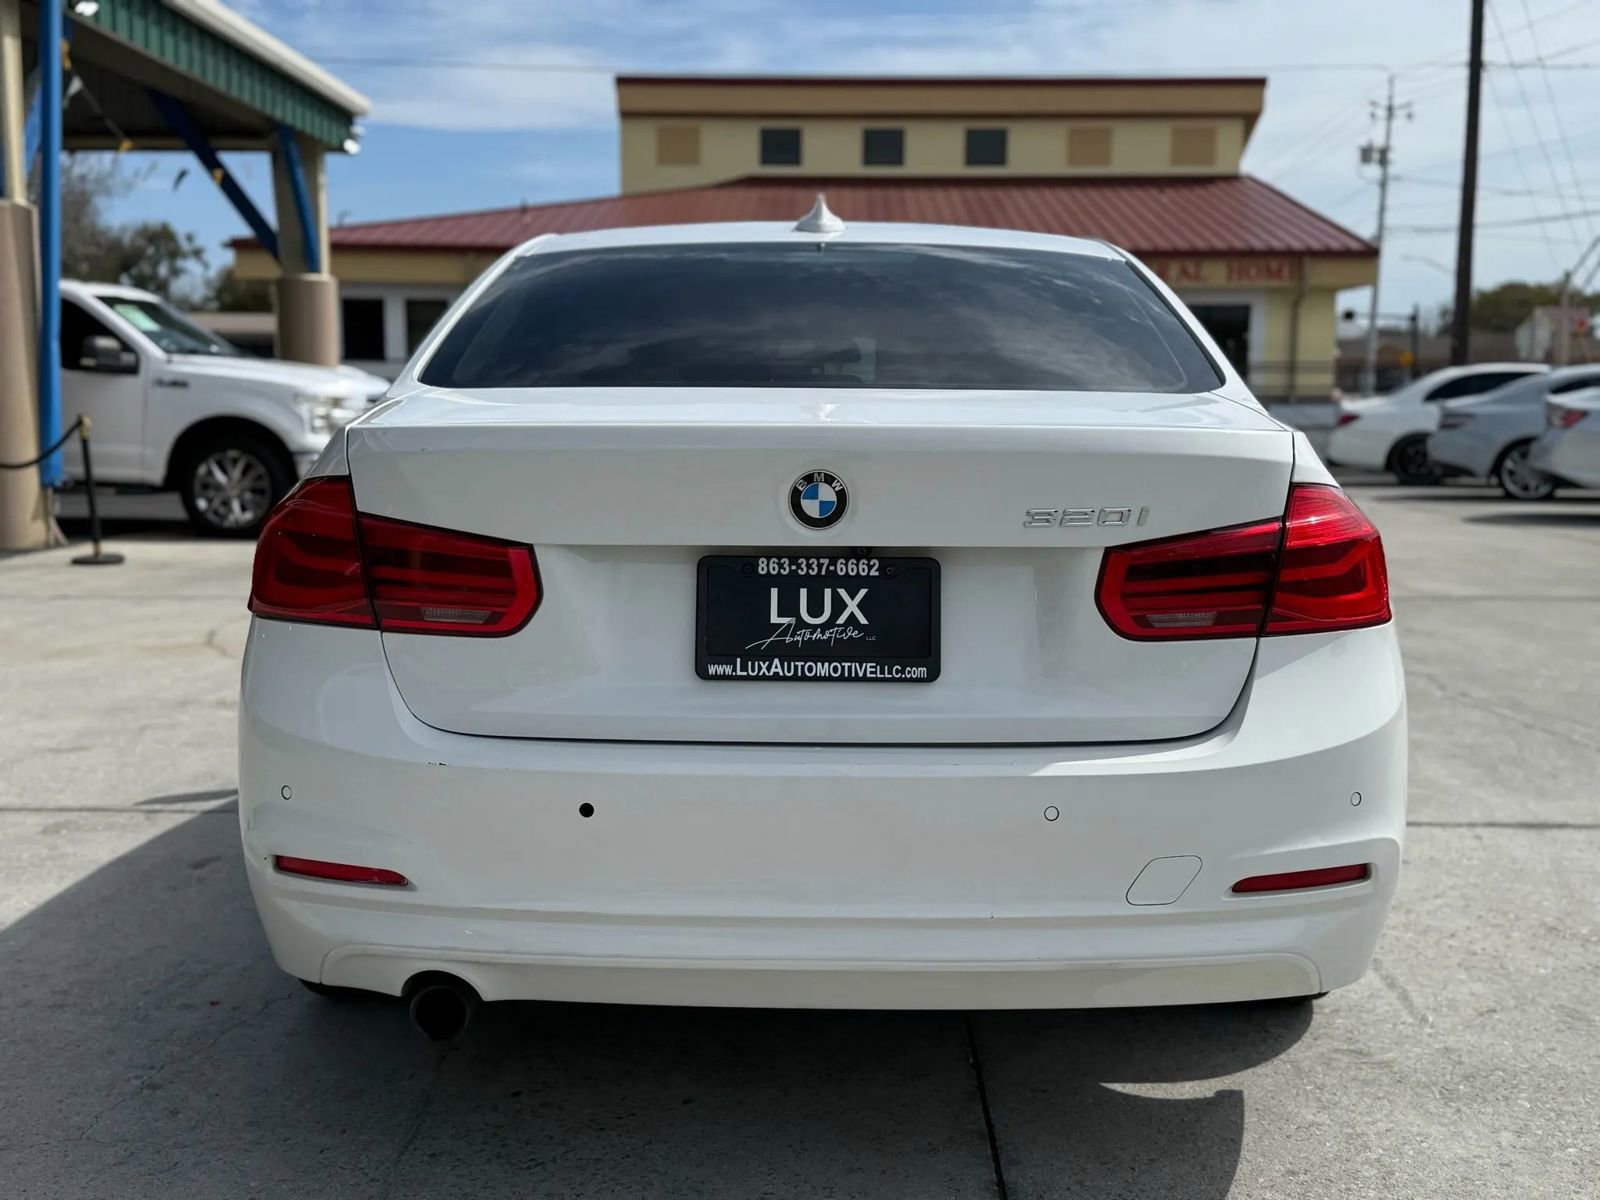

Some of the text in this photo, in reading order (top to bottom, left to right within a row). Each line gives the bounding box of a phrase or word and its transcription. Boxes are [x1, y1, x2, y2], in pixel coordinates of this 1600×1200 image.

[795, 472, 844, 492] BMW
[757, 557, 880, 577] 863-337-6662
[769, 587, 870, 625] LUX
[745, 617, 865, 650] Automotive
